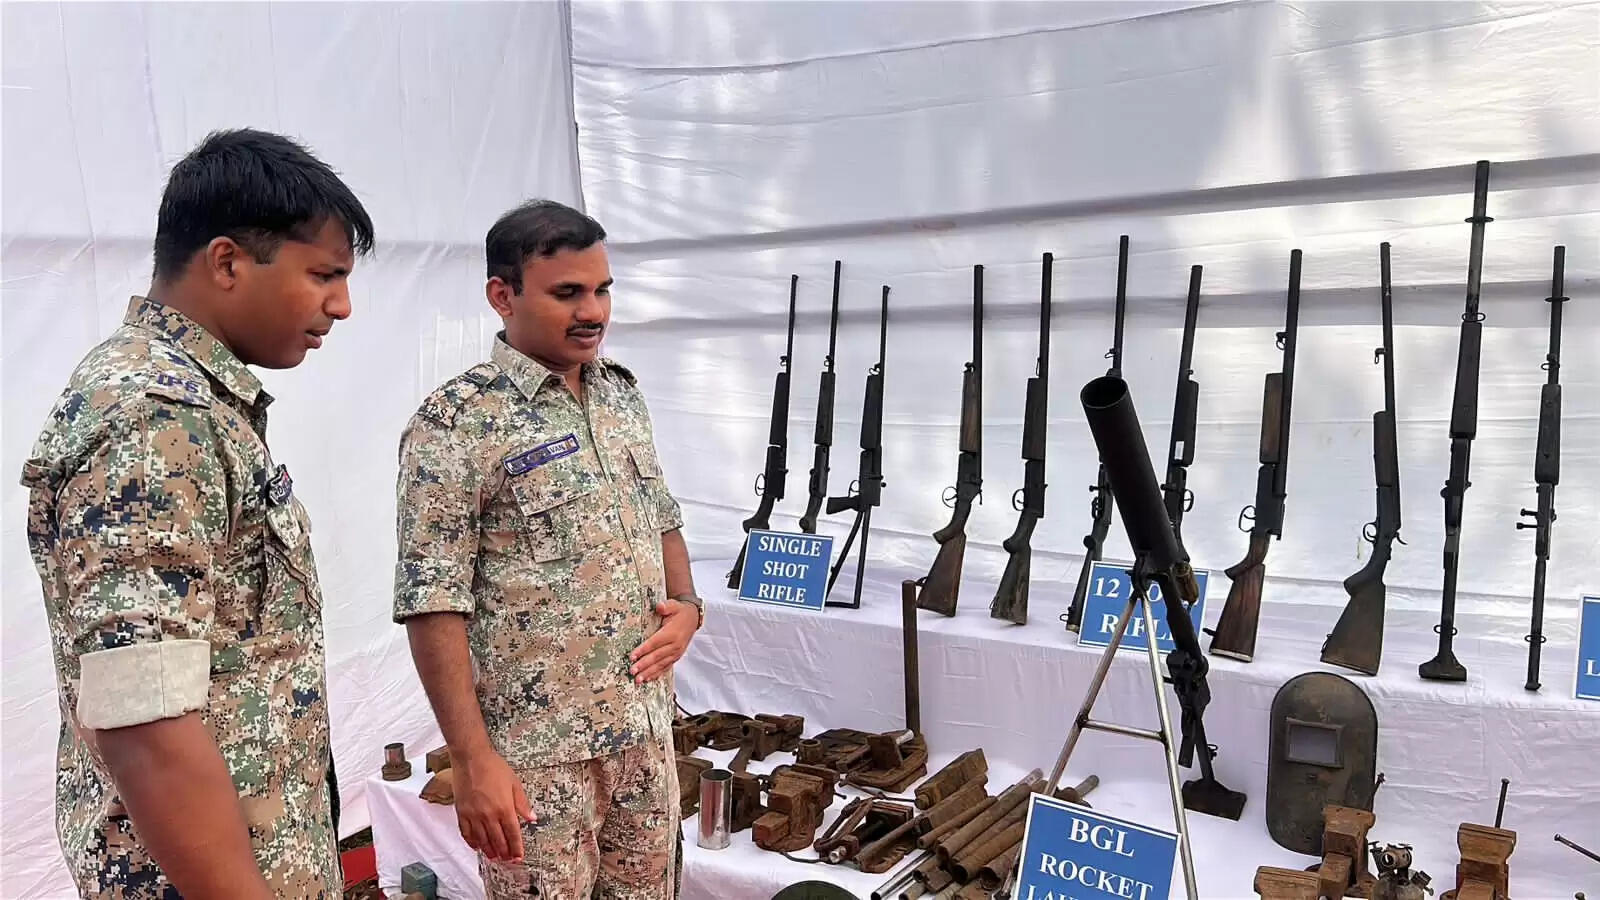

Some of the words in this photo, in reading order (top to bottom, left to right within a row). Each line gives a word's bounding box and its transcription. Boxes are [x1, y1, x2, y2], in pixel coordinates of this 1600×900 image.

[758, 535, 822, 557] SINGLE
[762, 560, 809, 580] SHOT
[757, 583, 807, 603] RIFLE
[1092, 577, 1121, 598] 12
[1098, 613, 1174, 641] RFL
[1068, 817, 1136, 857] BGL
[1039, 852, 1154, 900] ROCKET
